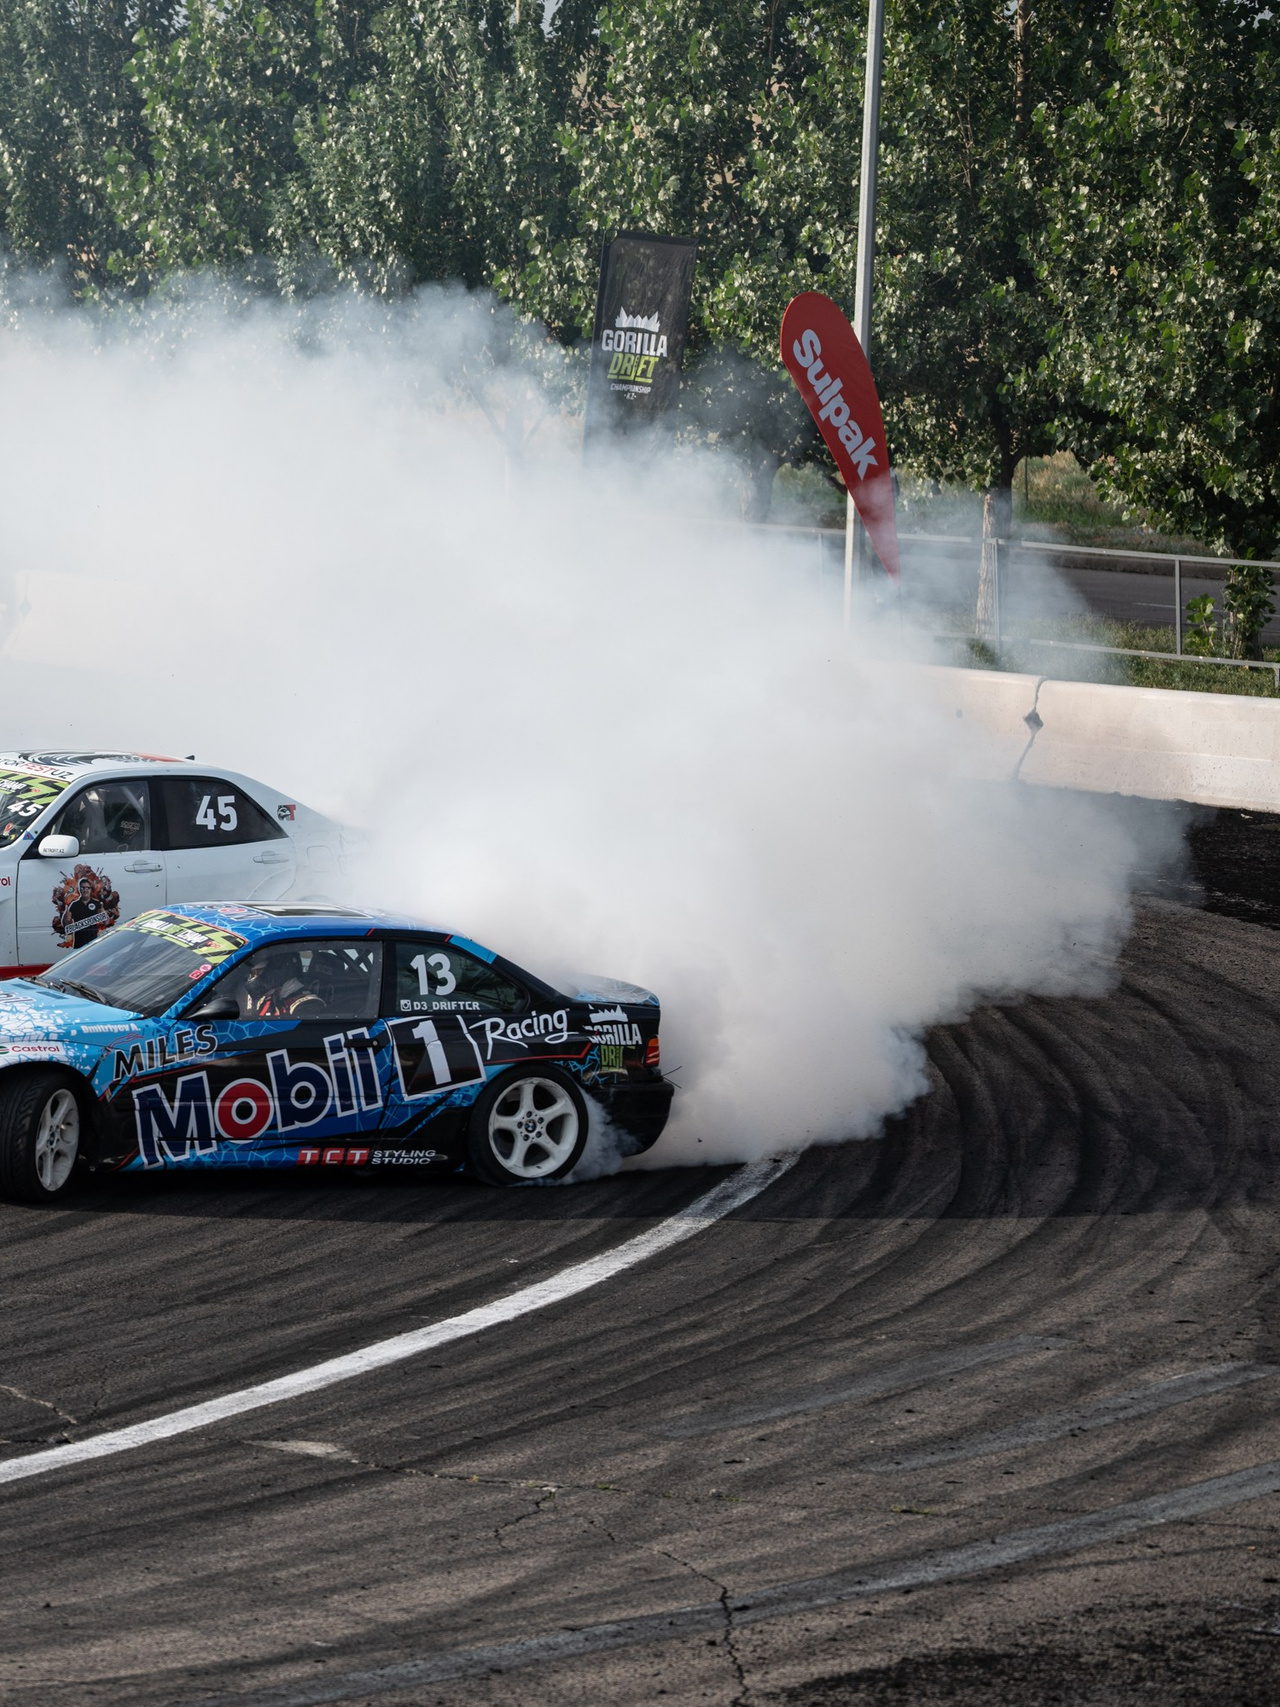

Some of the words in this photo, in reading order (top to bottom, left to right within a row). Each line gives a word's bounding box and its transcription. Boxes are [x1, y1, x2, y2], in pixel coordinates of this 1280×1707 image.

[601, 329, 668, 358] GORILLA
[607, 352, 660, 381] DRIFT
[792, 328, 879, 481] Sulpak
[7, 800, 44, 817] 45
[195, 795, 238, 832] 45
[410, 953, 456, 996] 13
[413, 1001, 480, 1012] D3_DRIFTER
[11, 1045, 60, 1053] Castrol
[113, 1024, 218, 1081] MILES
[132, 1026, 383, 1170] Mobil
[469, 1008, 579, 1060] Racing
[301, 1150, 368, 1164] TCT
[371, 1157, 431, 1165] STUDIO
[373, 1149, 436, 1158] STYLING
